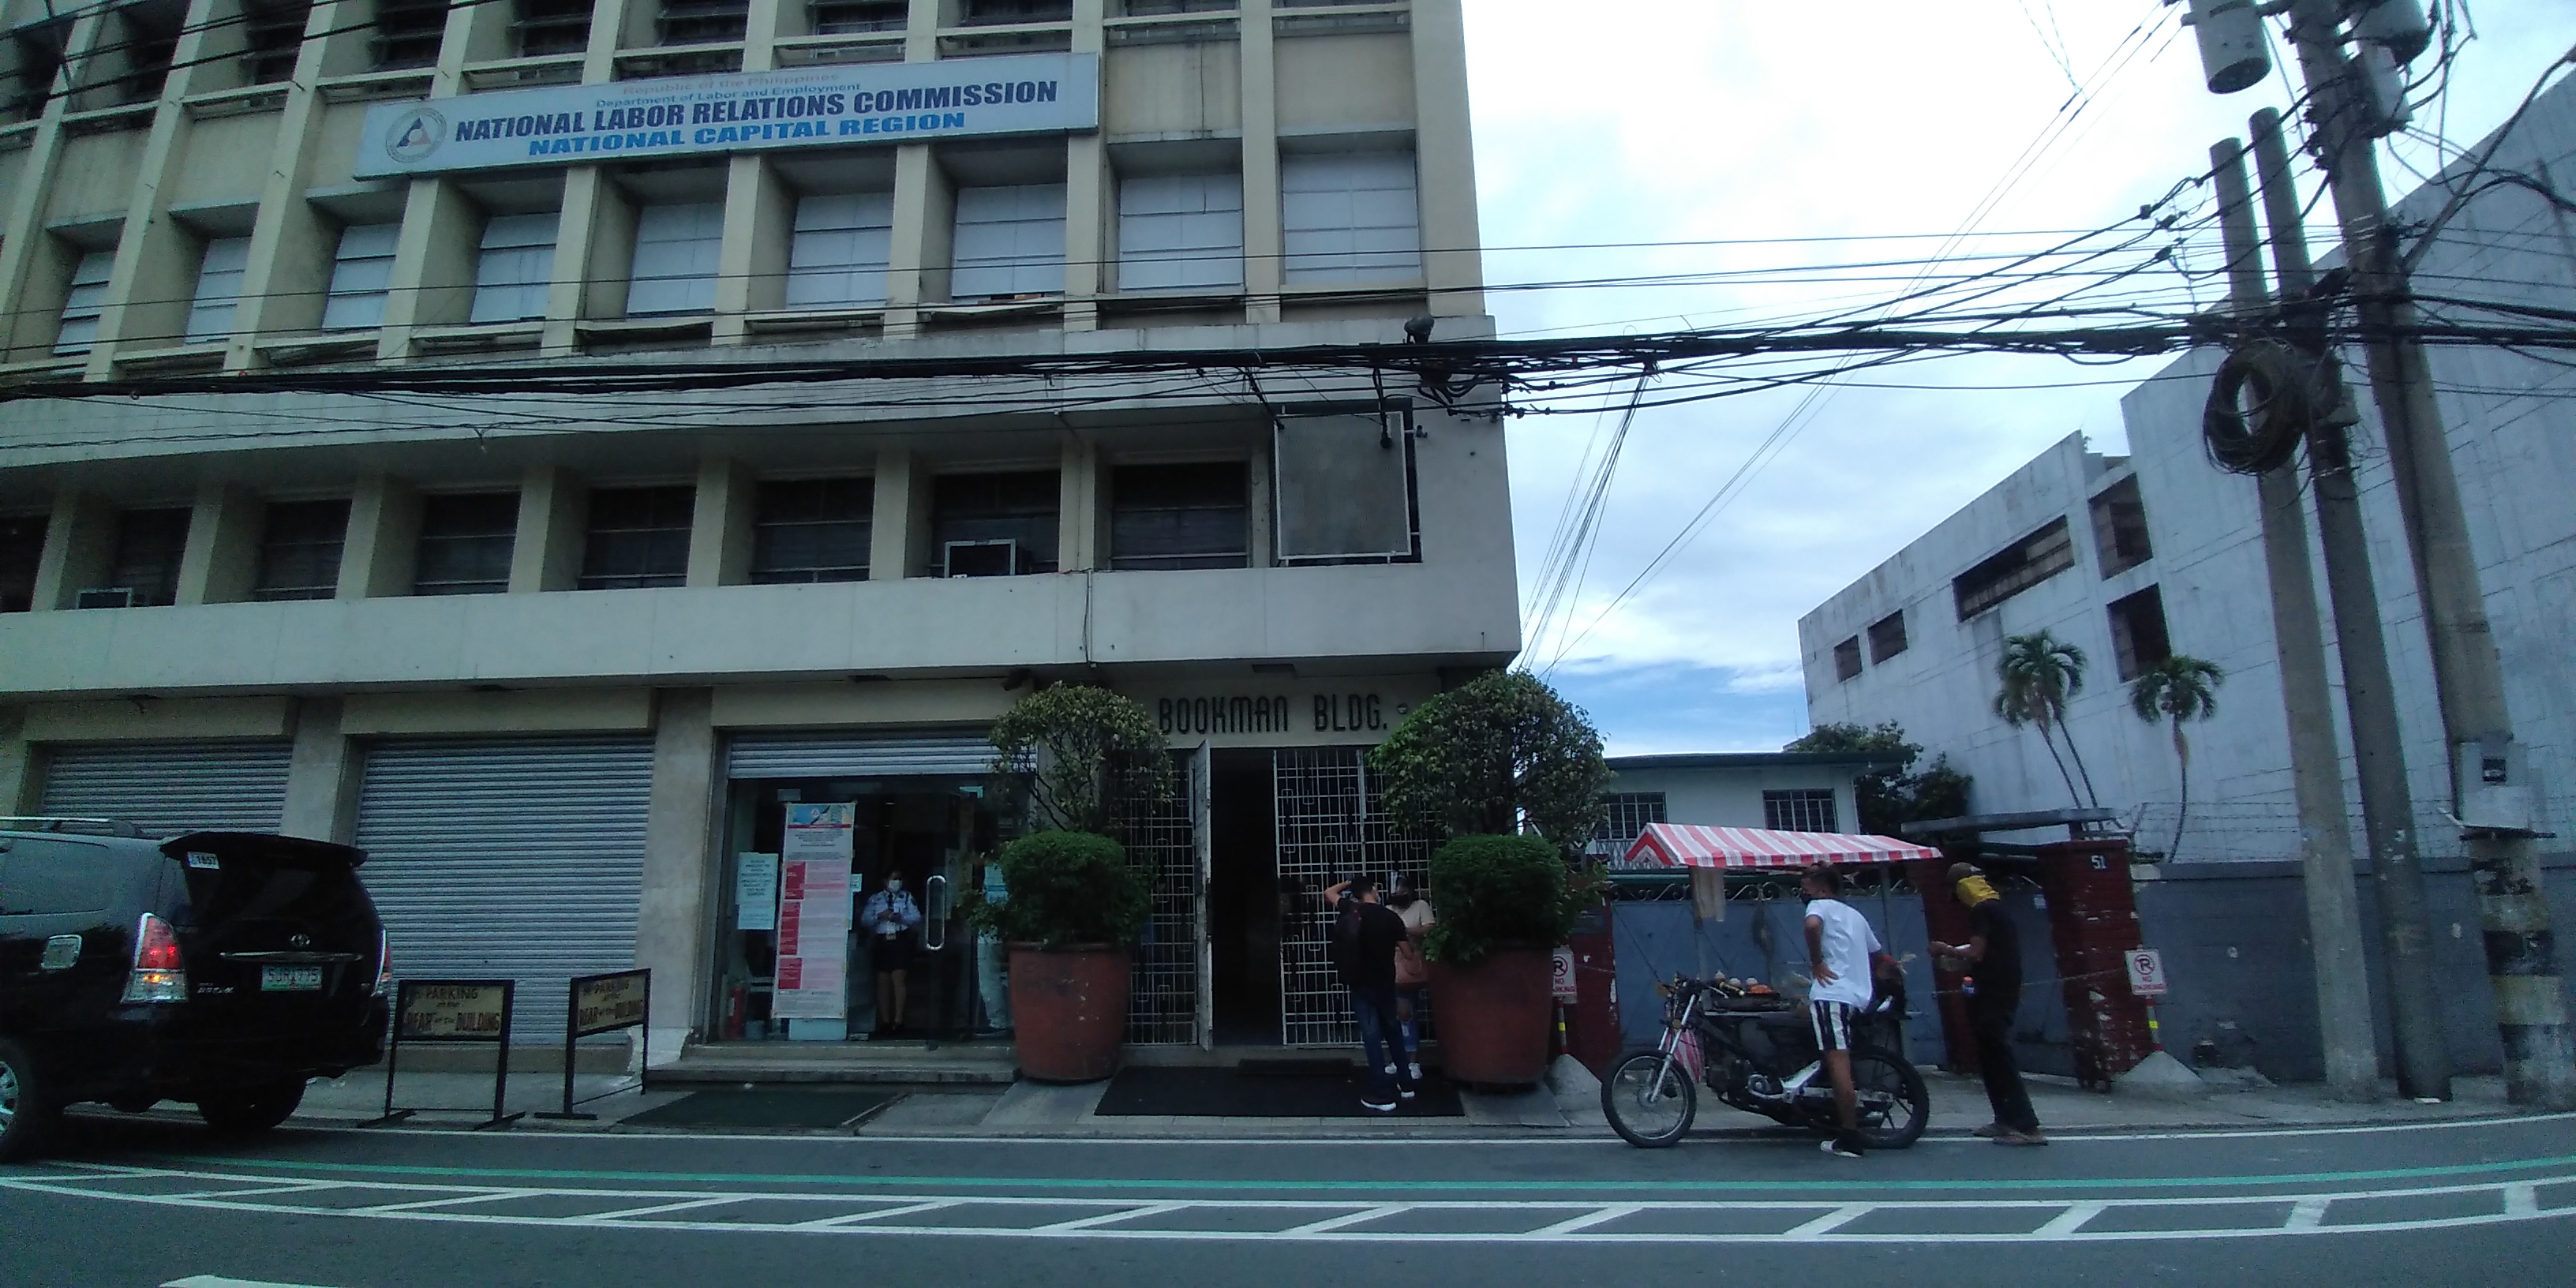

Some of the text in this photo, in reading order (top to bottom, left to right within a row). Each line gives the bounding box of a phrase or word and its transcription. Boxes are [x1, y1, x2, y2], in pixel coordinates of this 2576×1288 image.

[596, 83, 861, 108] Department of Labor and Employment
[623, 73, 839, 95] Republic of the Philippines
[455, 112, 586, 142] NATIONAL
[593, 103, 684, 132] LABOR
[692, 93, 844, 125] RELATIONS
[853, 80, 1058, 114] COMMISSION
[529, 112, 965, 156] NATIONAL CAPITAL REGION
[1159, 693, 1387, 735] BOOKMAN BLDG.
[2091, 855, 2106, 869] 51
[425, 986, 478, 1000] PARKING
